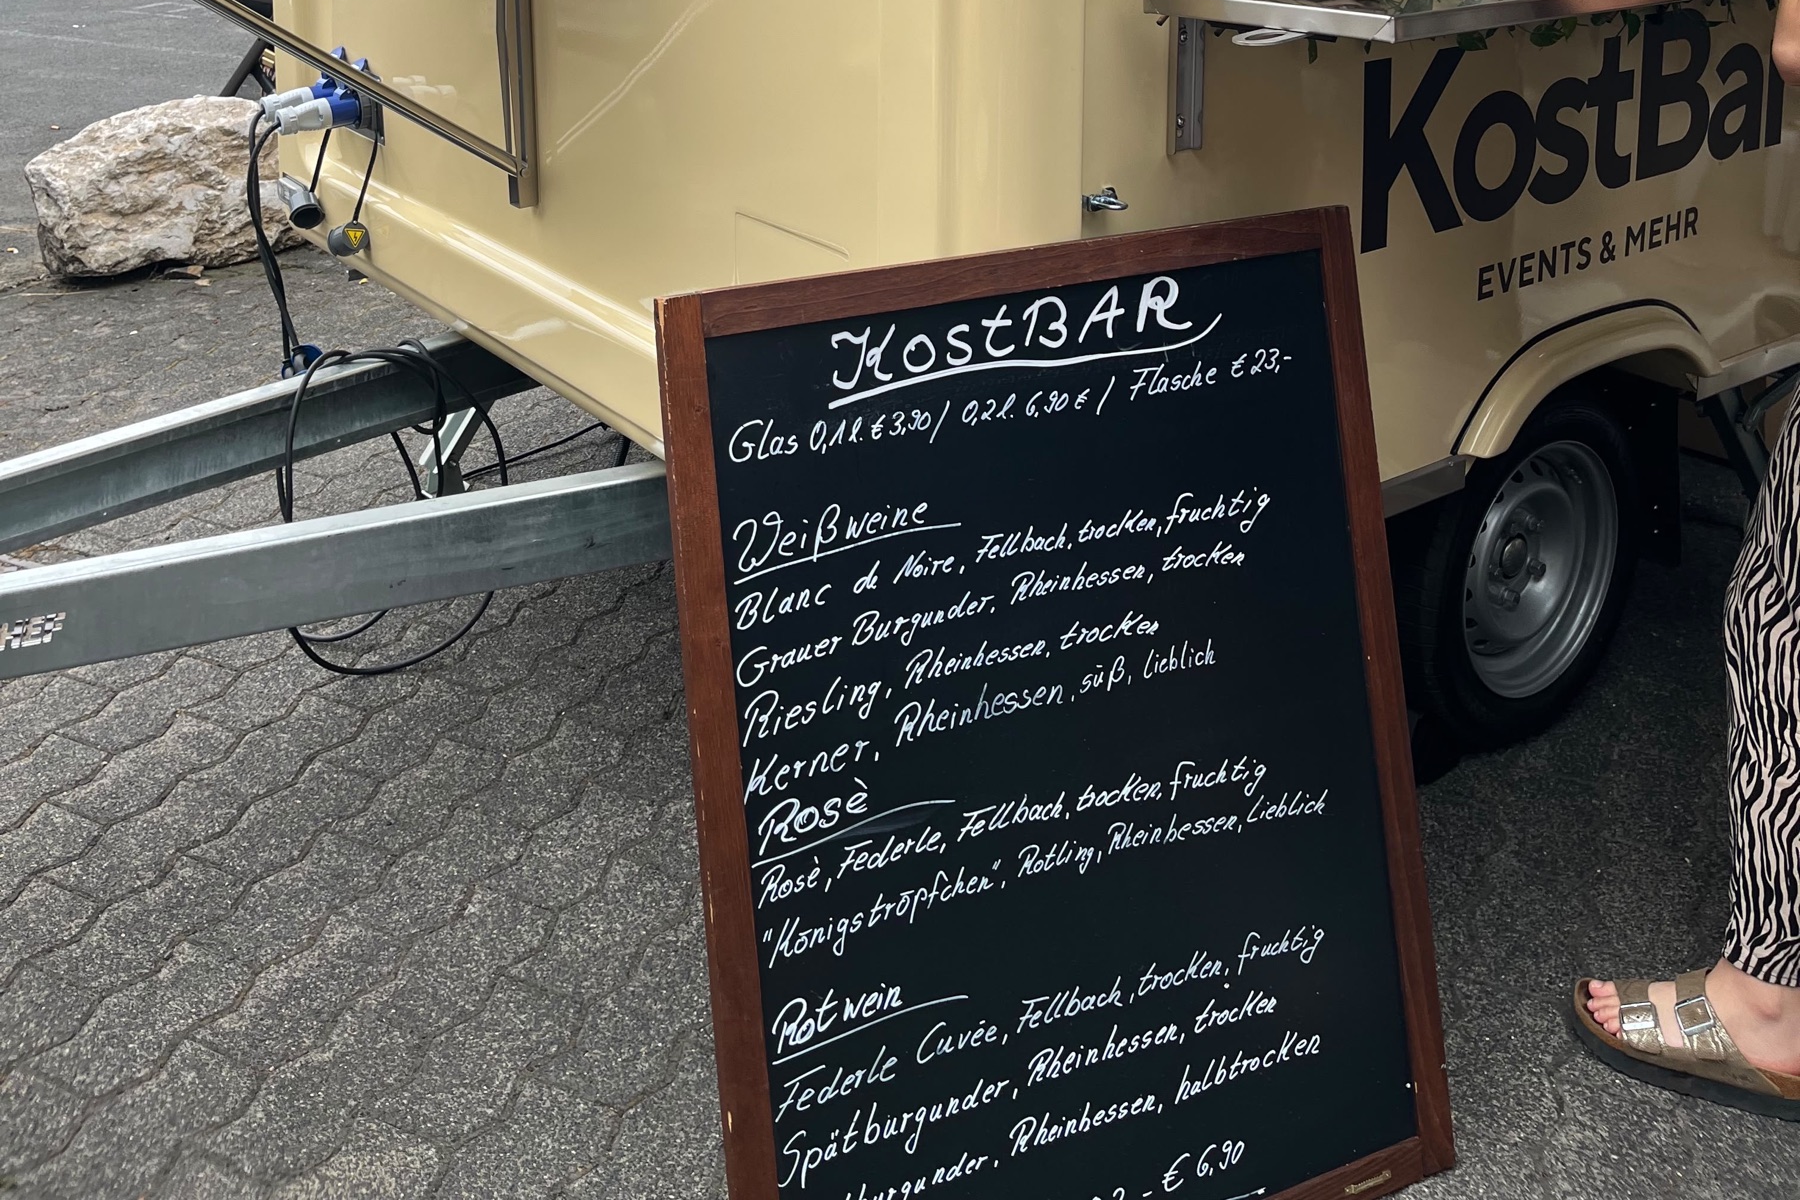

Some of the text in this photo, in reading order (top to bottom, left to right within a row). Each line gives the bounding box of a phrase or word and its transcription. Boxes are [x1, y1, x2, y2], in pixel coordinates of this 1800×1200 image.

[1477, 206, 1700, 302] EVENTS & MEHR
[729, 418, 800, 463] Glas
[1129, 361, 1217, 401] Flasche
[734, 584, 832, 630] Blanc
[853, 560, 880, 594] de
[1164, 487, 1271, 534] fruchtig
[736, 636, 843, 688] Grauer
[1161, 541, 1246, 572] trocken
[1059, 610, 1160, 651] trocken
[1169, 755, 1267, 801] fruchtig
[774, 1045, 899, 1124] Federle
[1237, 924, 1325, 976] fruchtig
[1193, 990, 1279, 1035] trocken
[1174, 1030, 1322, 1106] halbtrocken
